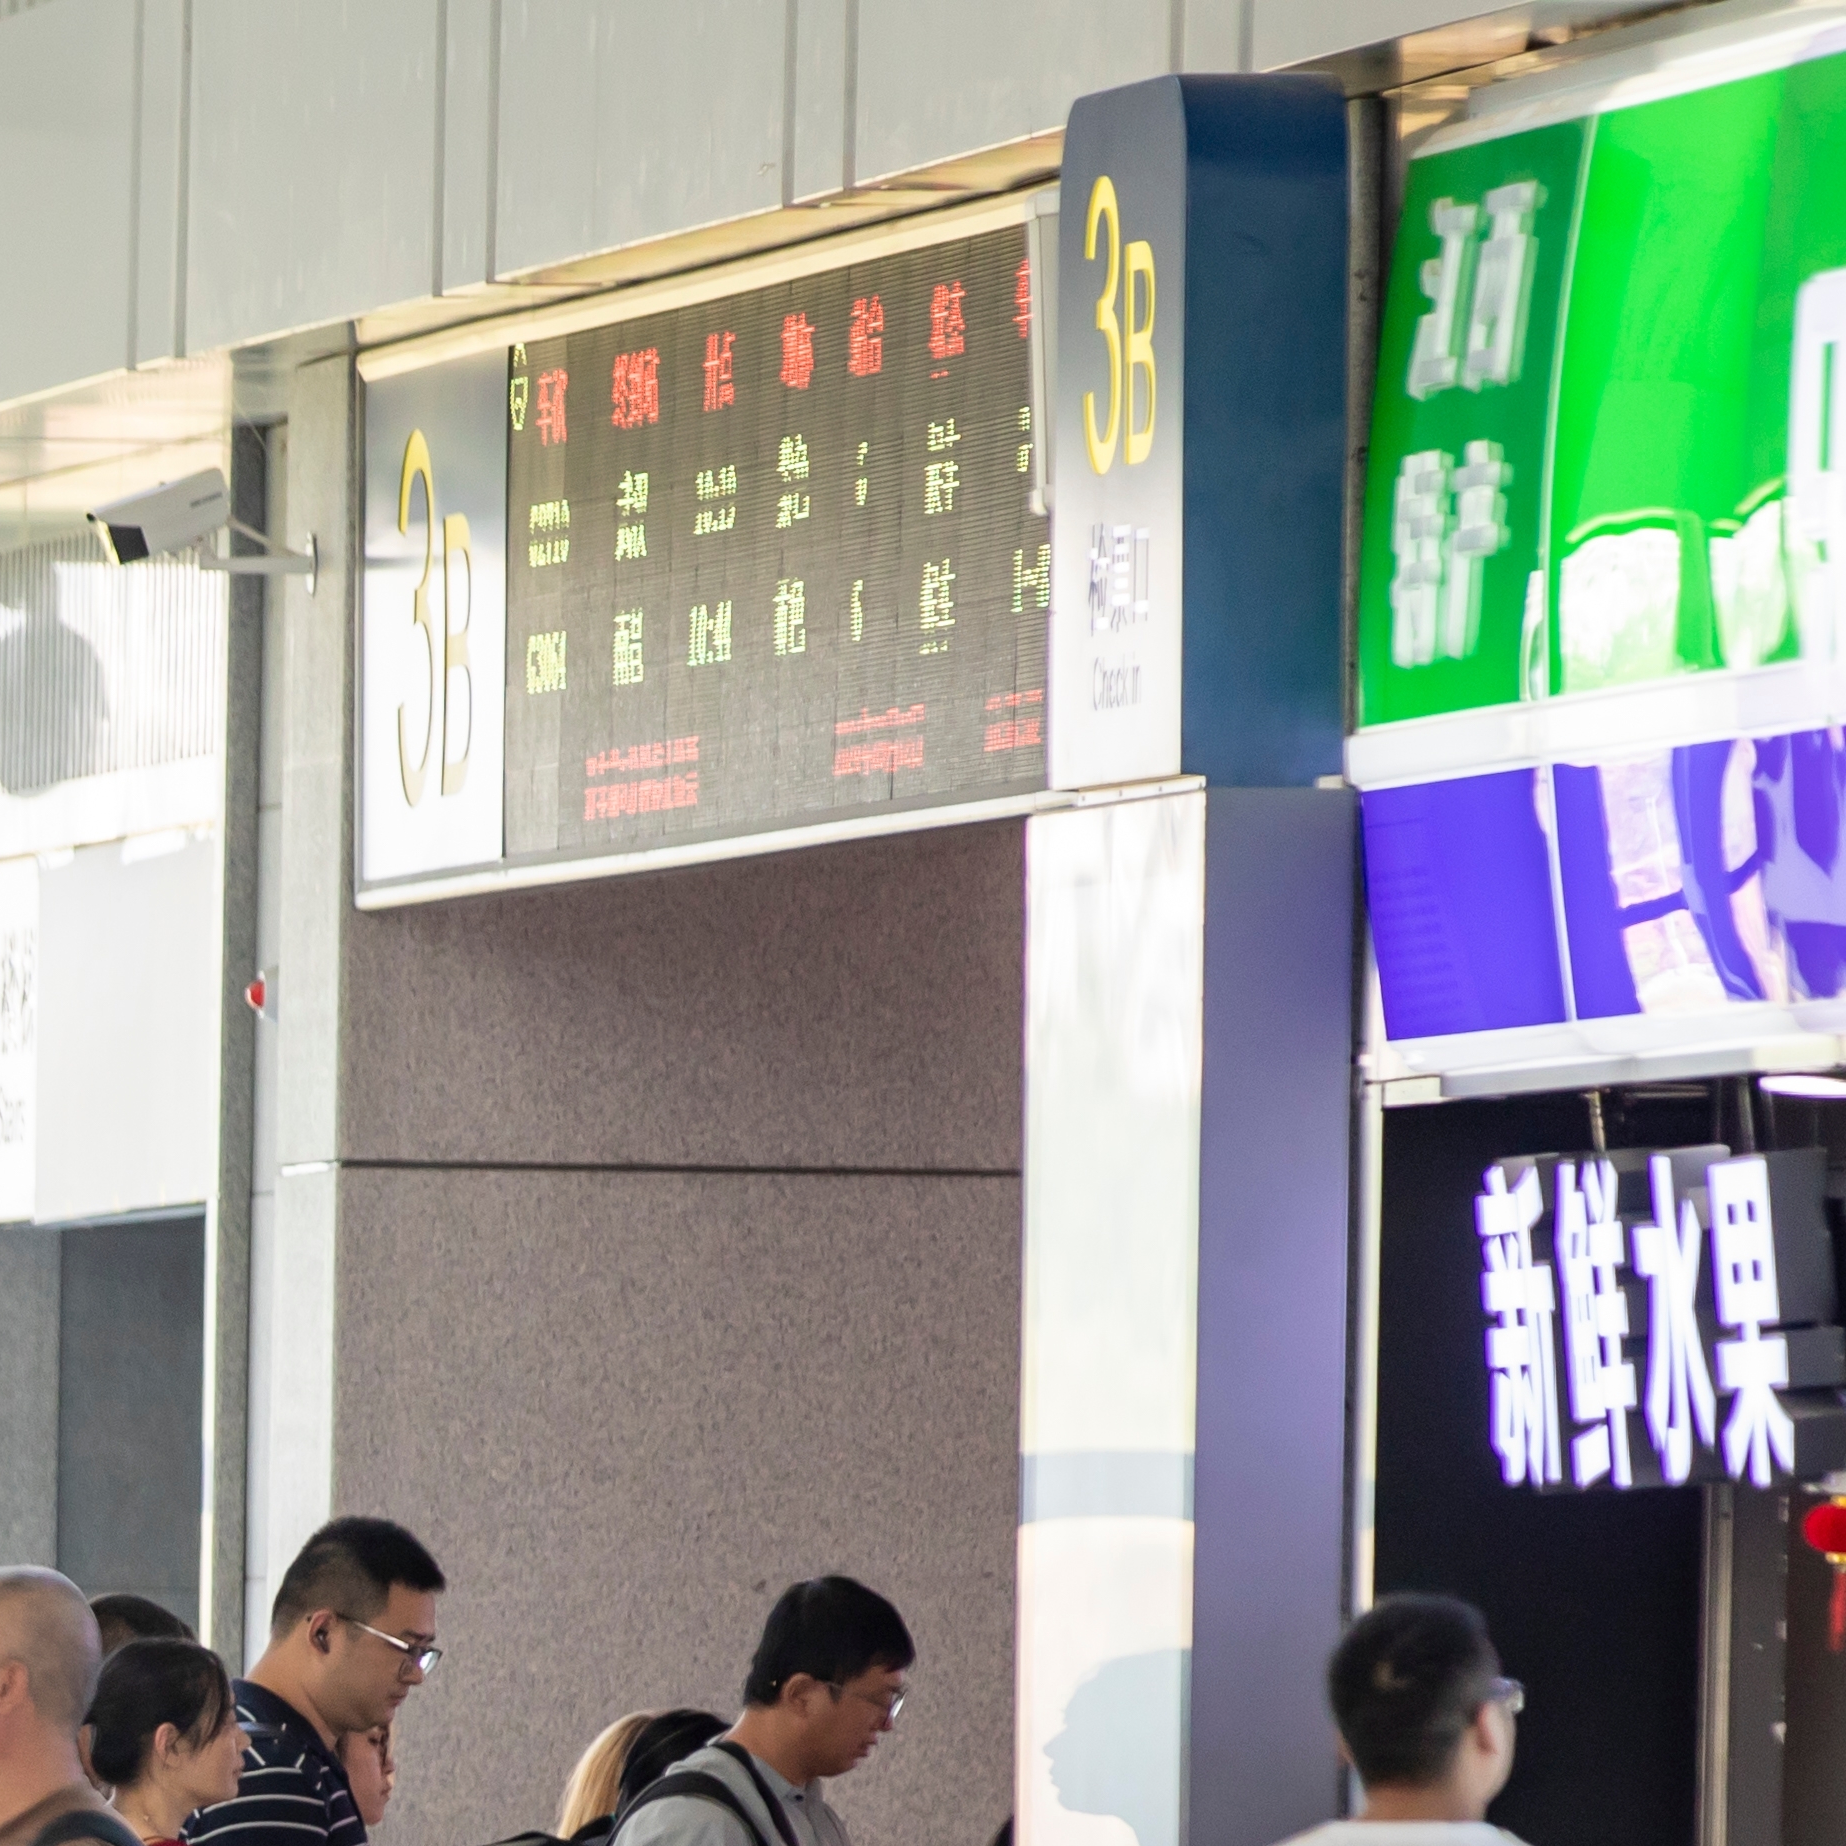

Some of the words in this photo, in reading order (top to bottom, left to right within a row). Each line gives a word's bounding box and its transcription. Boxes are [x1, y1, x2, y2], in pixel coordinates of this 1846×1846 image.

[1084, 175, 1156, 476] 3B
[397, 428, 471, 807] 3B
[1087, 523, 1151, 638] 检票口
[1093, 653, 1129, 710] Check
[1475, 1150, 1795, 1488] 新鲜水果
